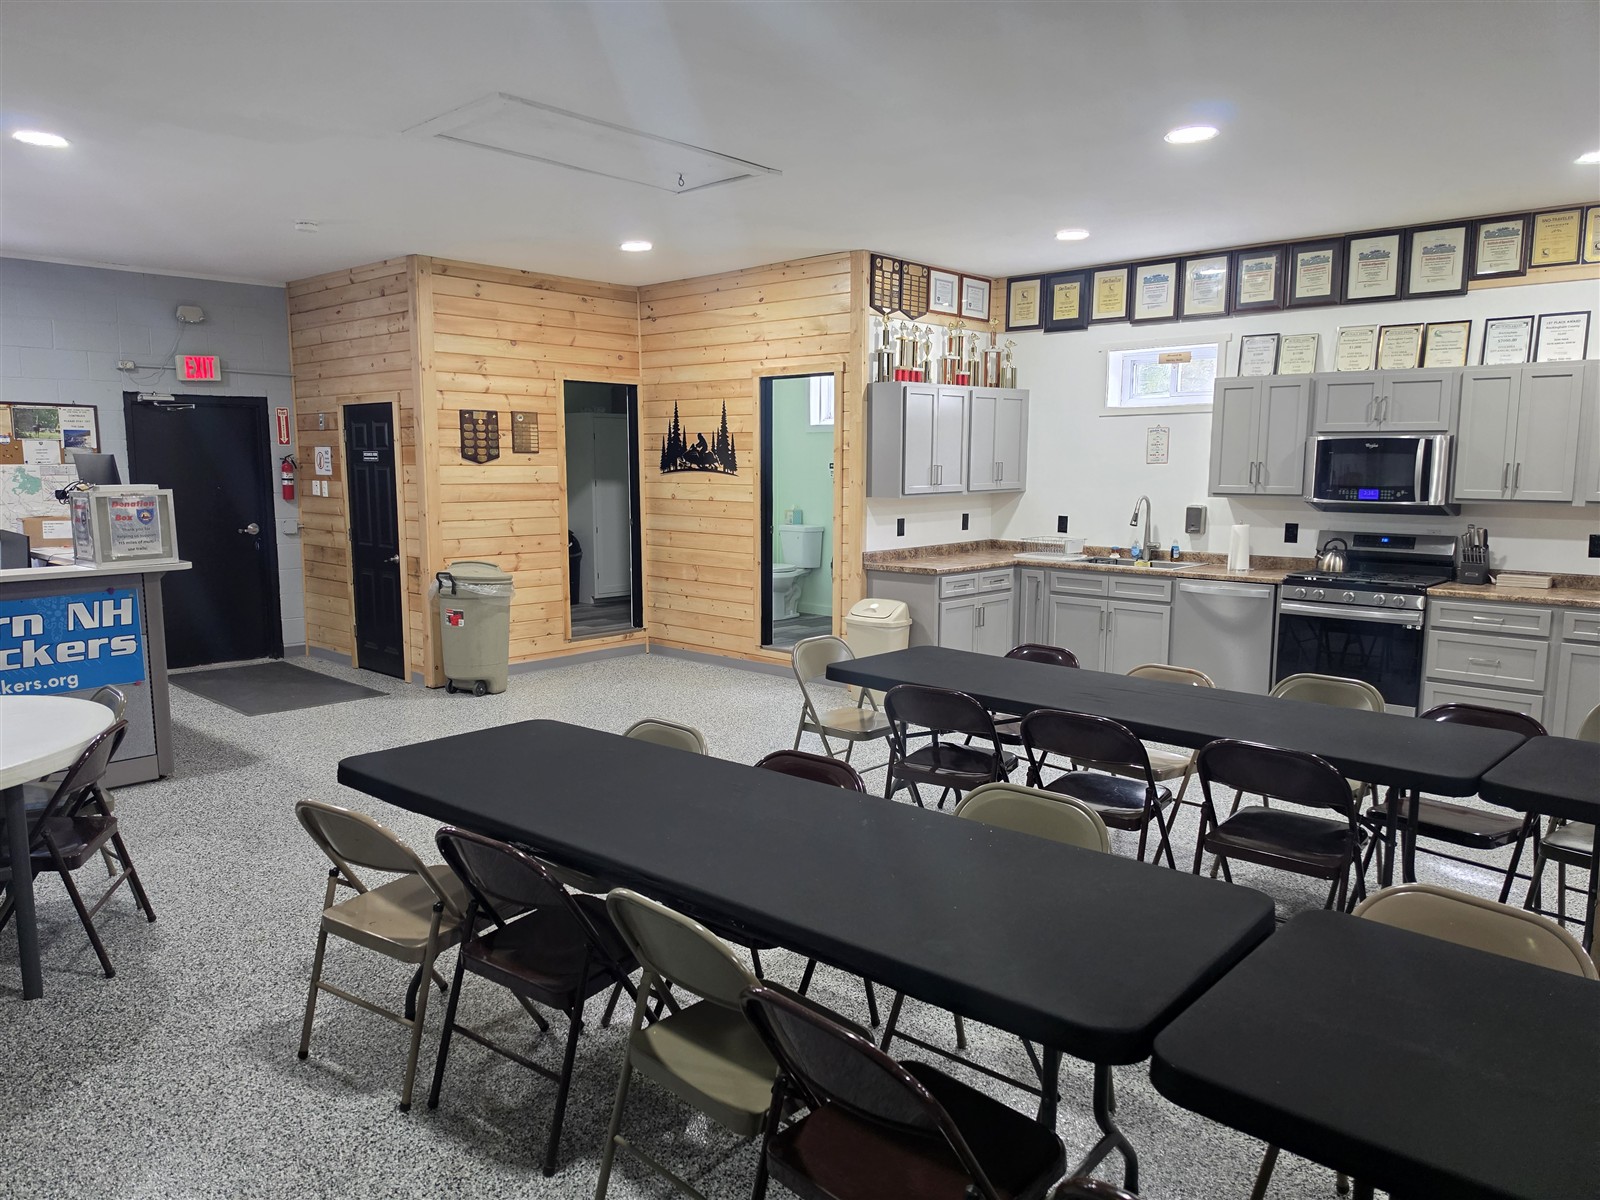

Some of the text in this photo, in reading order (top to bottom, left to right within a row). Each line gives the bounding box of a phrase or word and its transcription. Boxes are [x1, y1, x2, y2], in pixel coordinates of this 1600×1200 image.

[185, 356, 214, 379] EXIT
[112, 500, 155, 508] Donation
[68, 598, 132, 631] NH
[1, 674, 79, 694] kers.org
